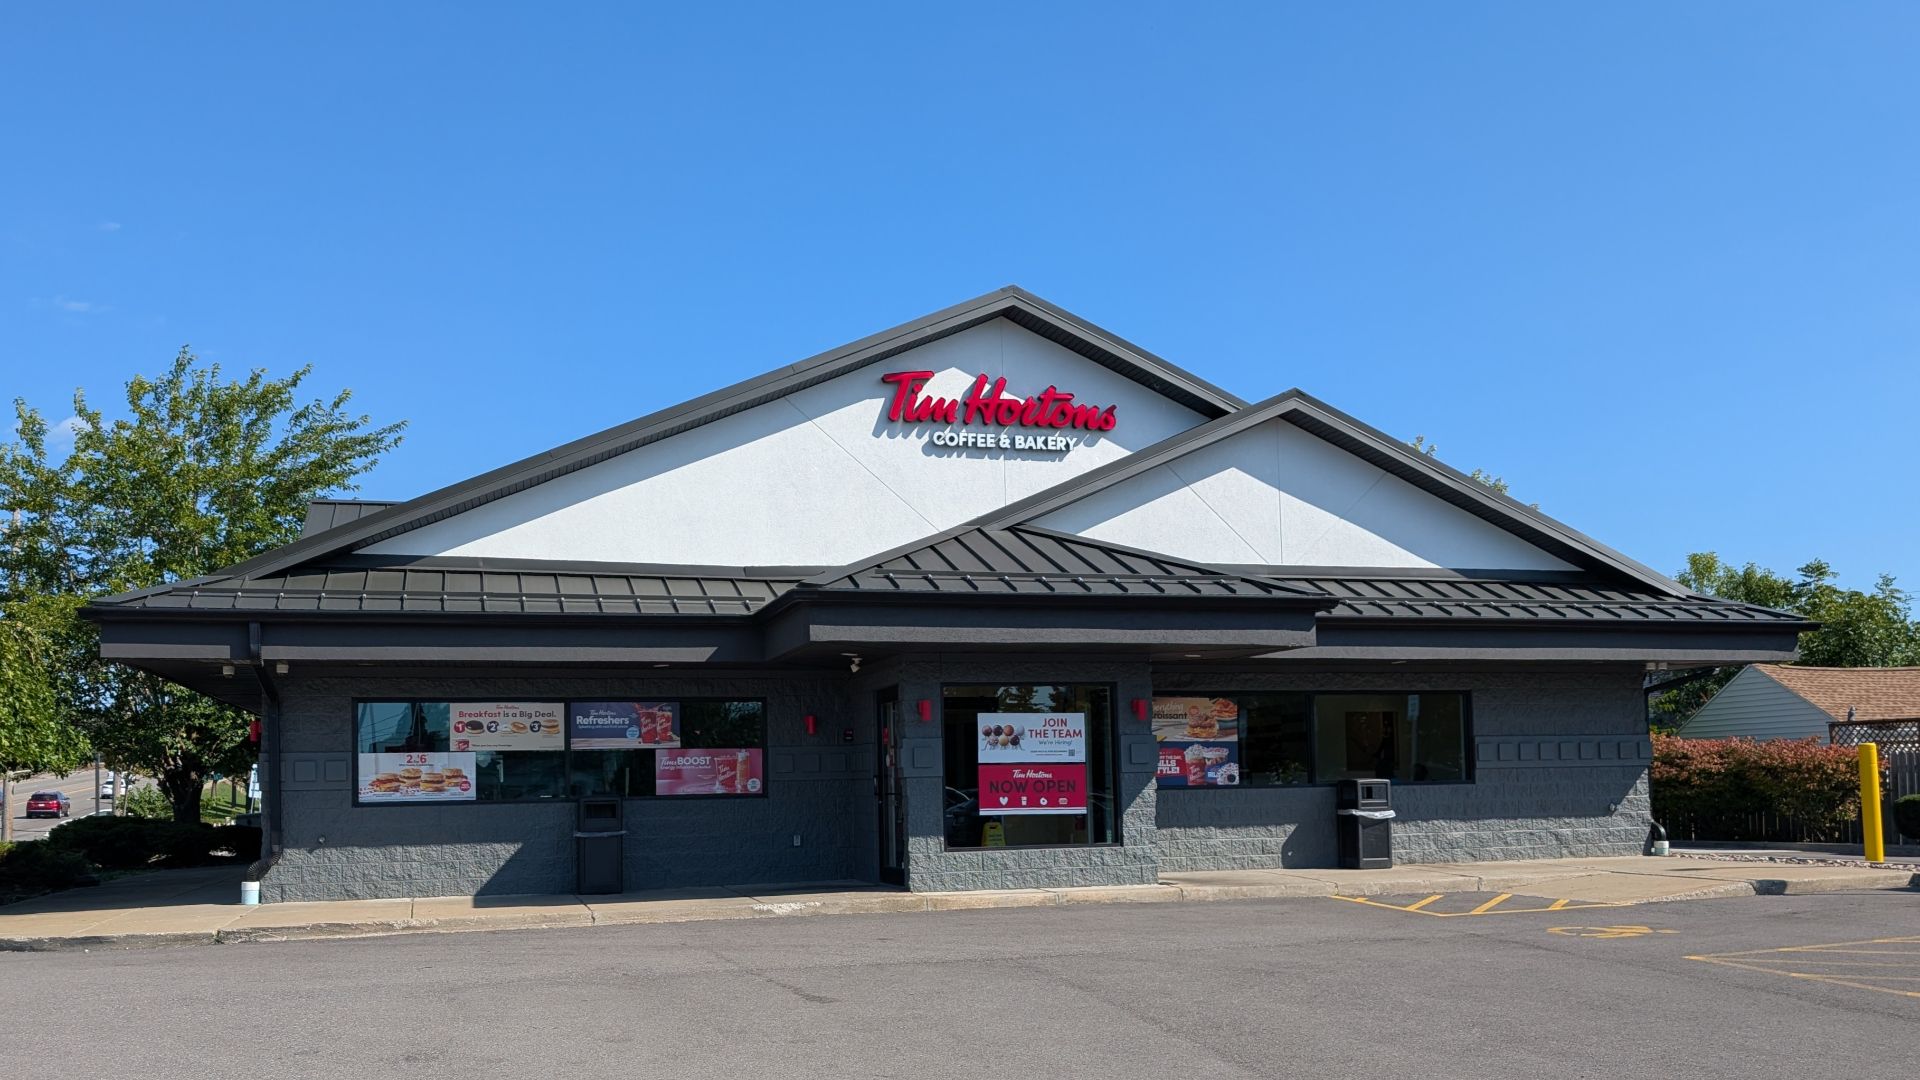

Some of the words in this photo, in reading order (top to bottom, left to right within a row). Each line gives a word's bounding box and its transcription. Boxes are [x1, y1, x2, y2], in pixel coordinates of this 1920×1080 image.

[882, 370, 958, 422] Tim
[963, 373, 1117, 431] Hortons
[933, 431, 995, 448] COFFEE
[999, 434, 1010, 448] &
[1015, 434, 1077, 451] BAKERY
[519, 711, 532, 719] Big
[1153, 711, 1187, 719] roissant
[576, 716, 629, 724] Refreshers
[1043, 718, 1067, 727] JOIN
[1028, 729, 1049, 738] THE
[1051, 729, 1082, 738] TEAM
[406, 754, 413, 763] 2
[677, 756, 711, 765] BOOST
[1012, 769, 1025, 778] Tim
[1026, 769, 1053, 778] Hortons
[989, 780, 1028, 793] NOW
[1033, 779, 1076, 793] OPEN
